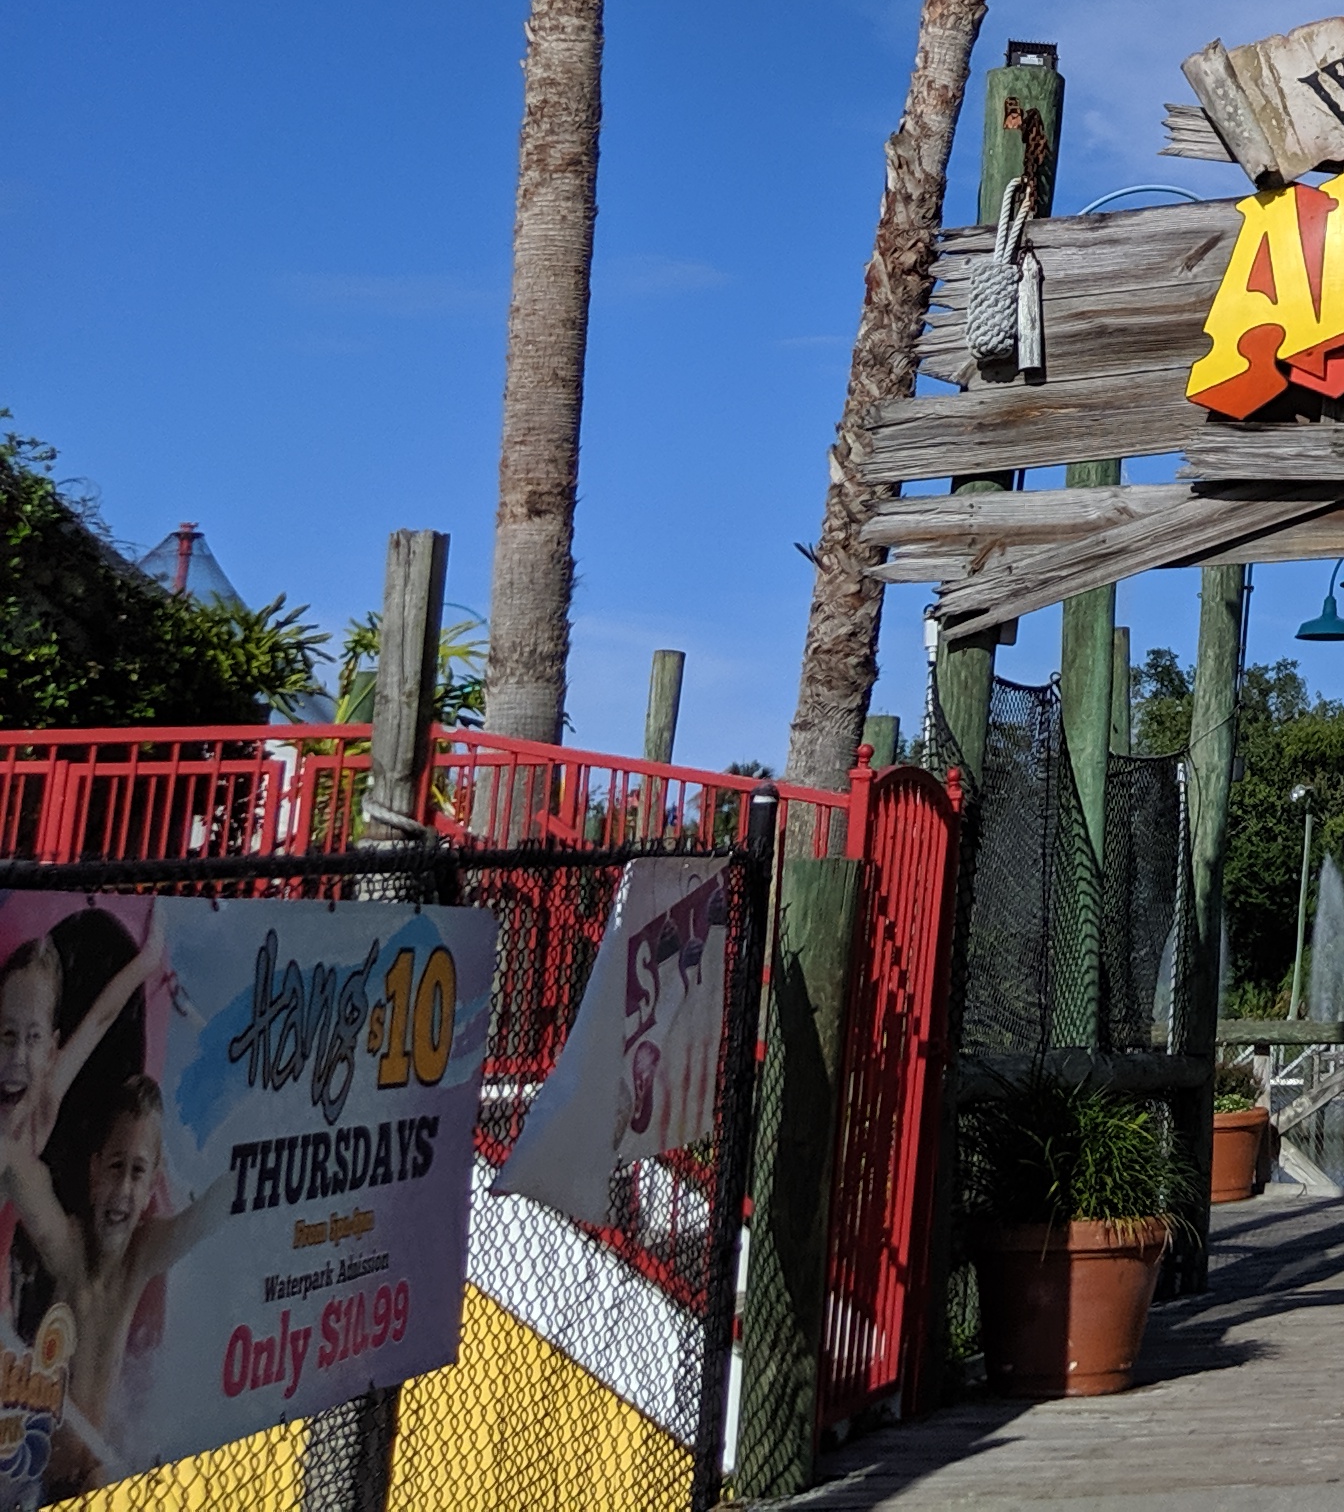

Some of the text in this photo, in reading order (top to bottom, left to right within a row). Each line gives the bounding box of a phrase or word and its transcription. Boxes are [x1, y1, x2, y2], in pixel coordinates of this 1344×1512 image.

[229, 928, 379, 1125] Hang
[367, 945, 457, 1090] $10
[230, 1115, 440, 1215] THURSDAYS
[264, 1259, 333, 1303] Waterpark
[221, 1308, 312, 1400] Only
